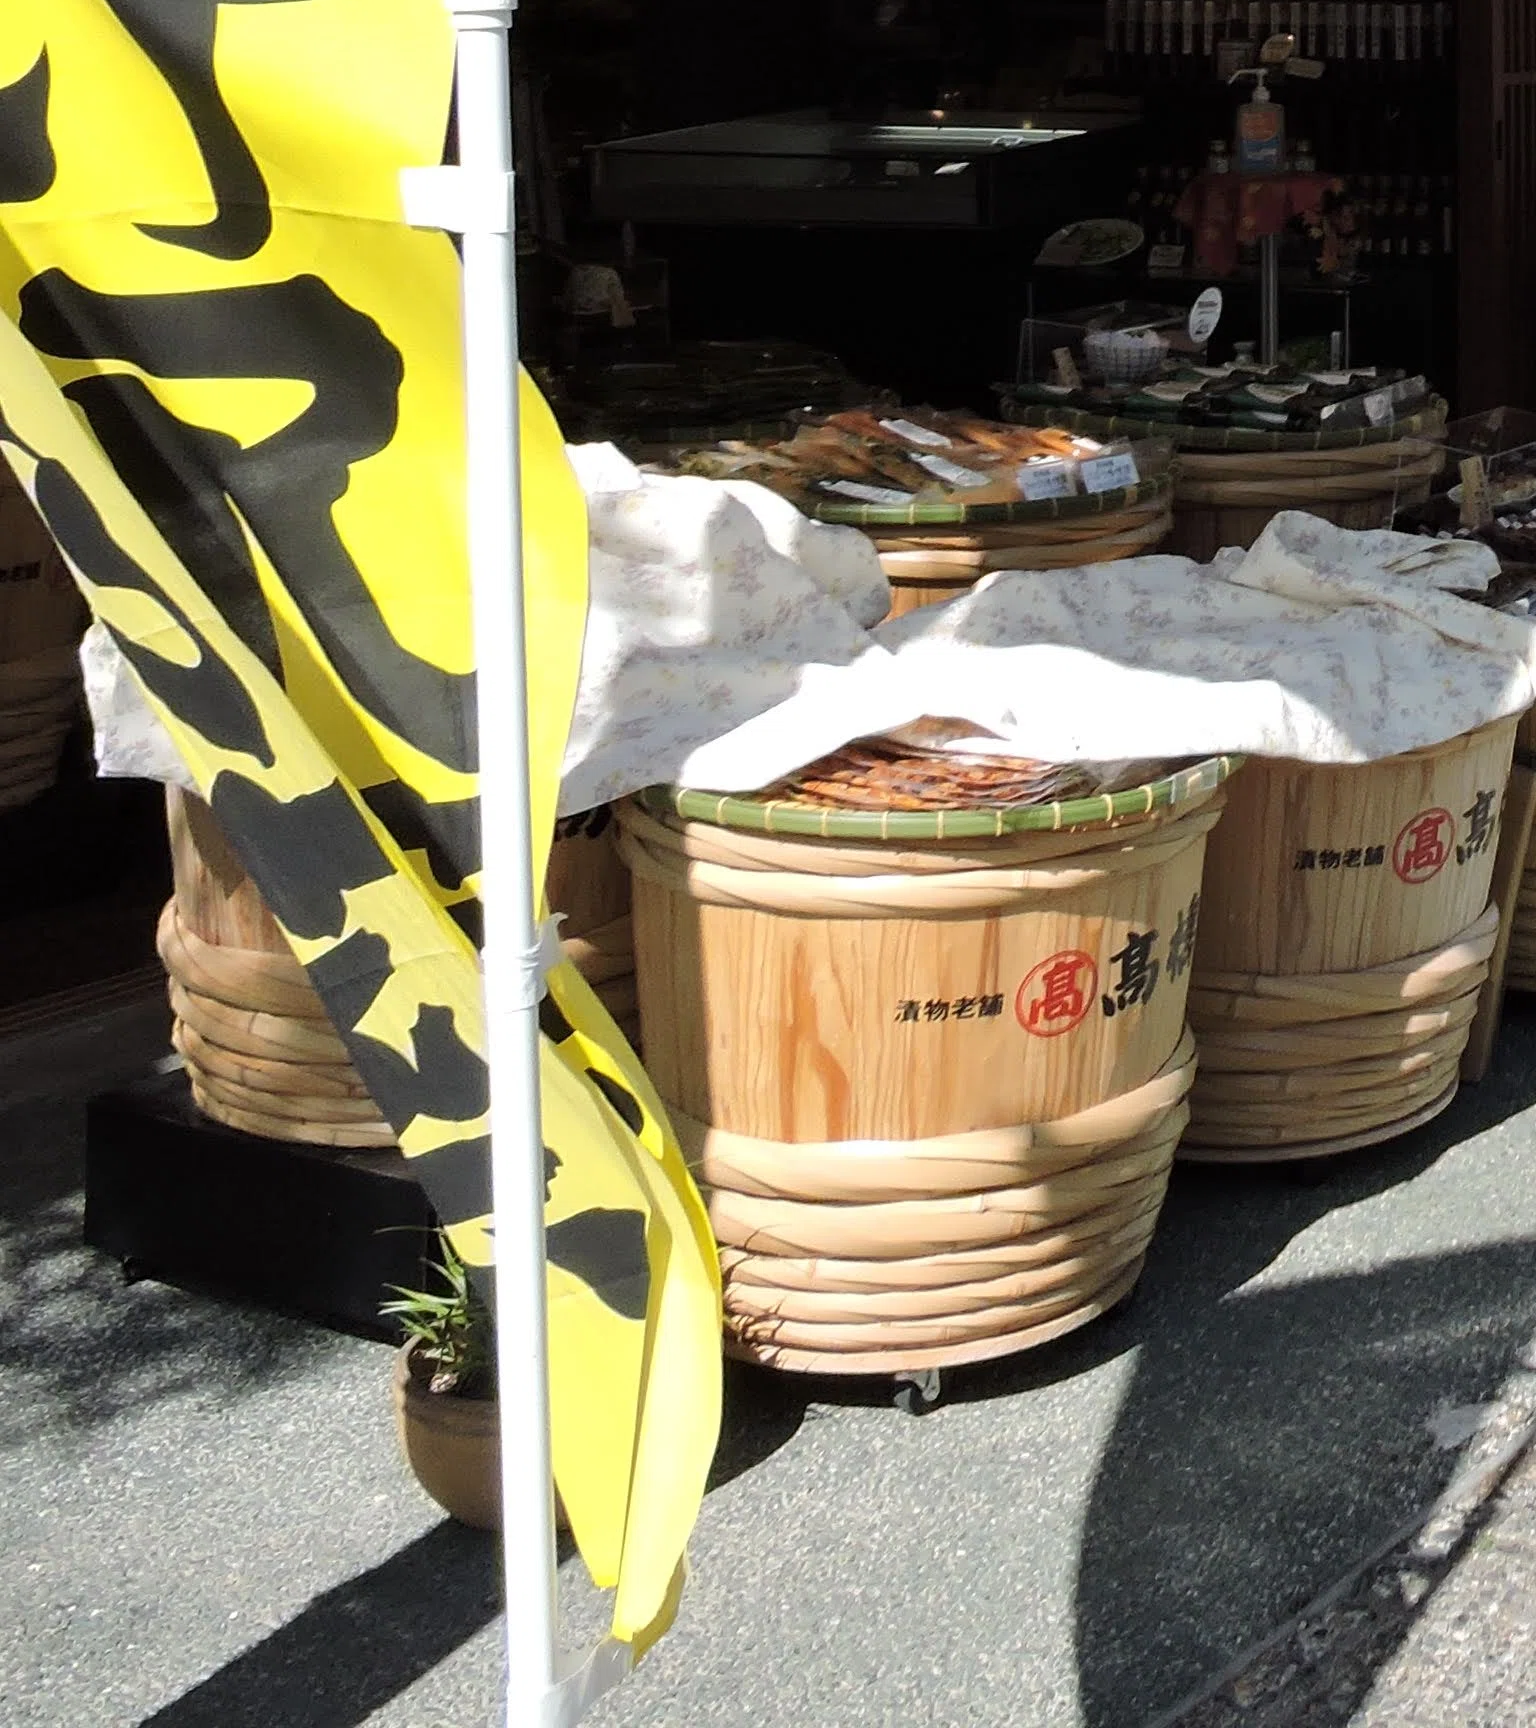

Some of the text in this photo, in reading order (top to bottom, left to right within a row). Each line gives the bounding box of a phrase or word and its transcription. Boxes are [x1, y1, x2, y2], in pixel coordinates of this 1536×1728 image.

[1293, 844, 1386, 871] 漬物老舗
[893, 992, 1004, 1024] 漬物老舗
